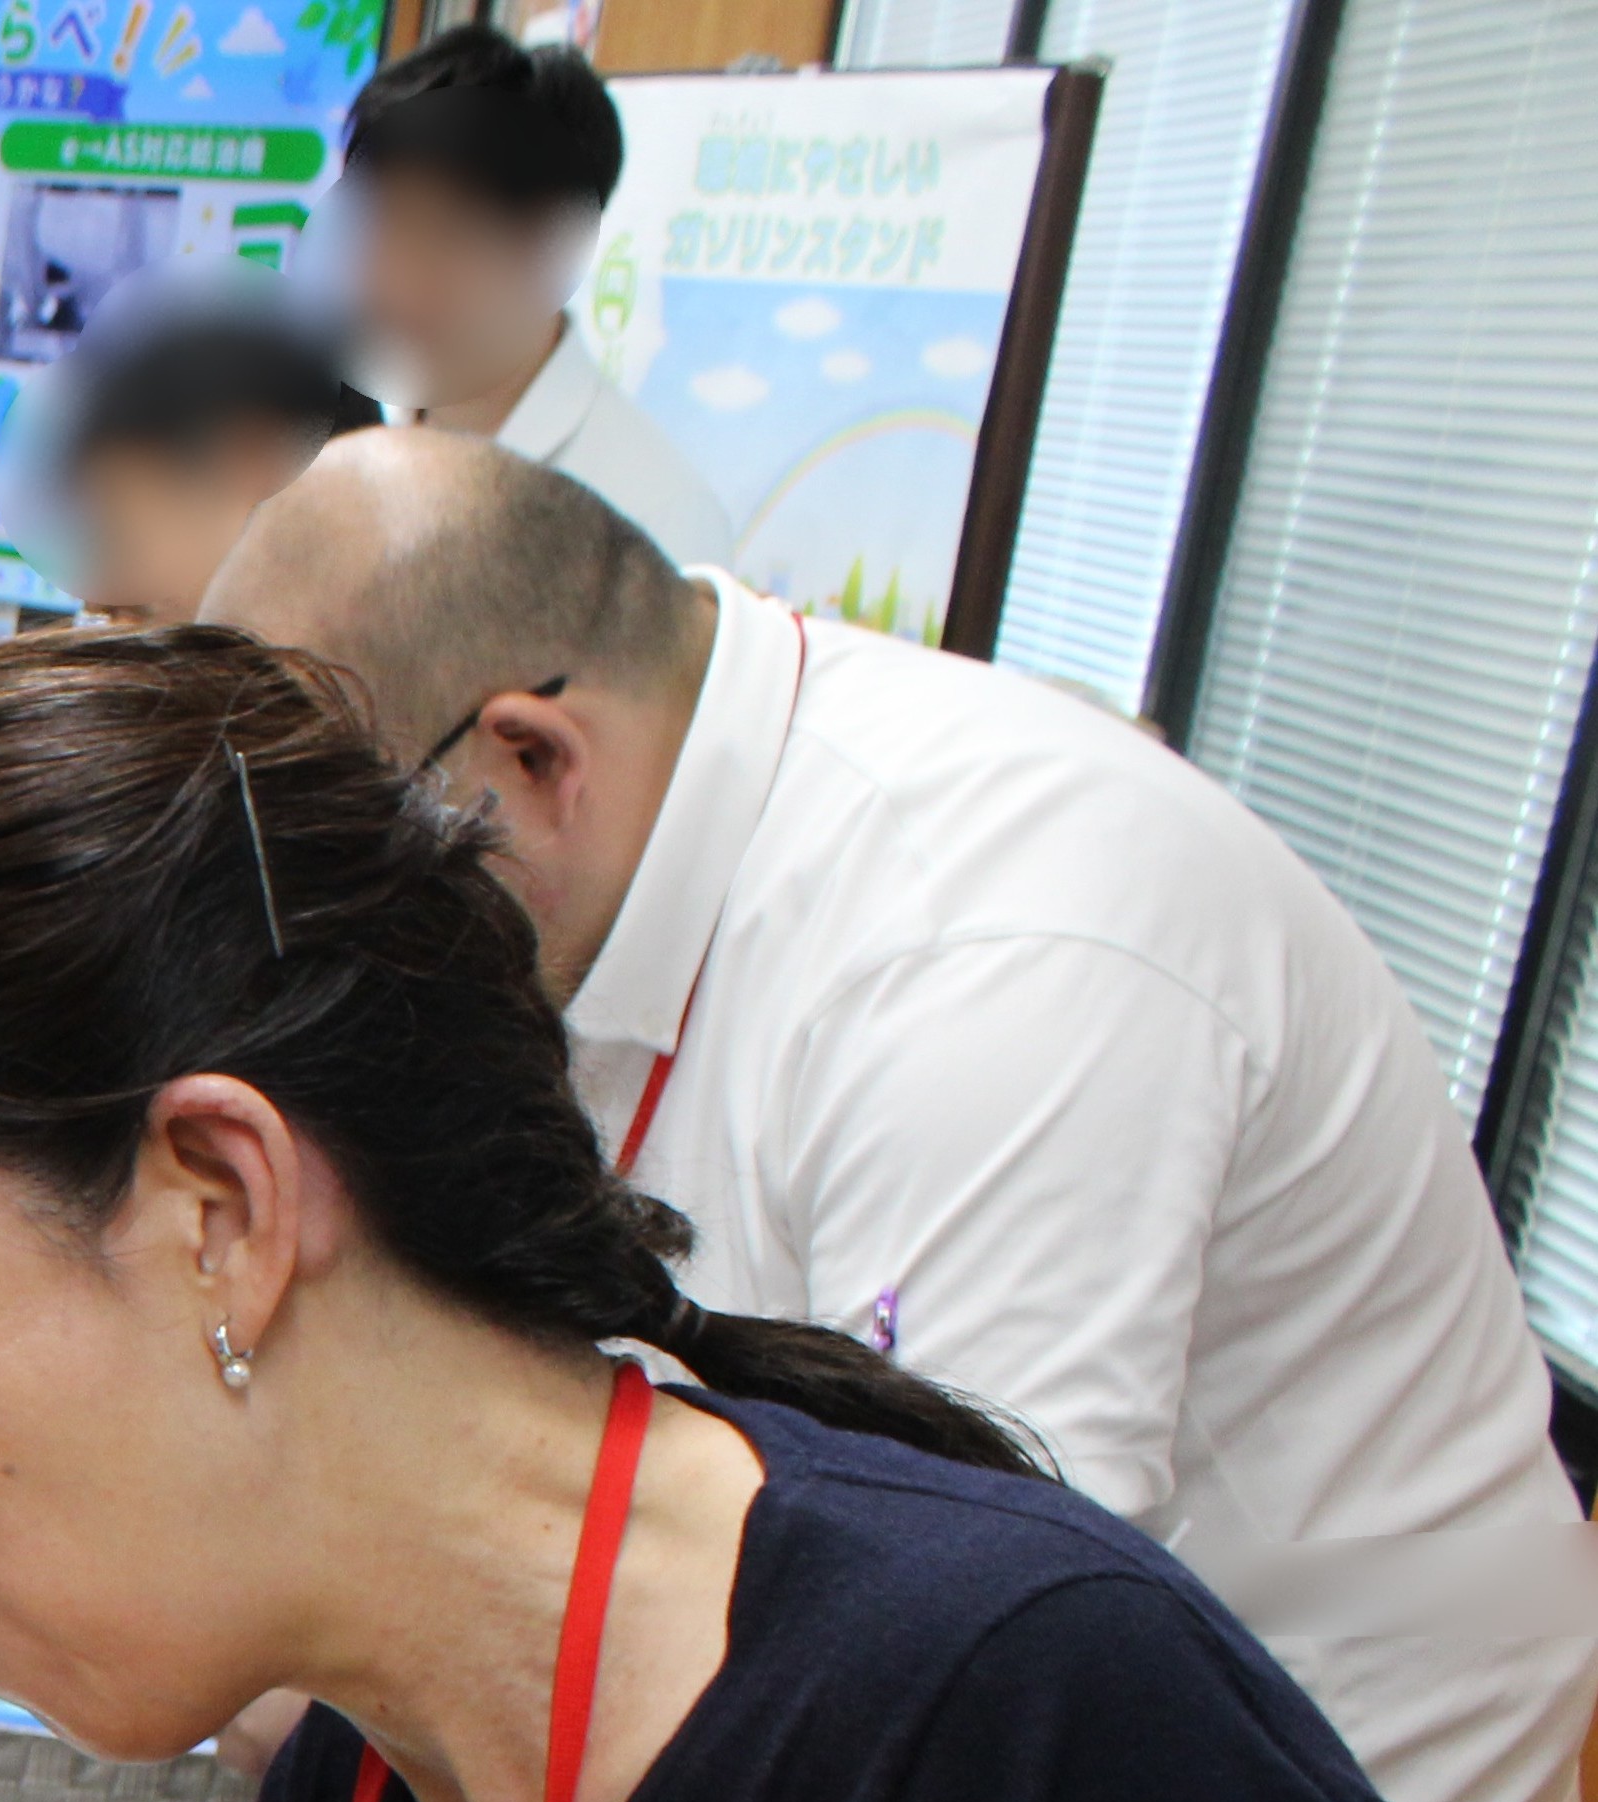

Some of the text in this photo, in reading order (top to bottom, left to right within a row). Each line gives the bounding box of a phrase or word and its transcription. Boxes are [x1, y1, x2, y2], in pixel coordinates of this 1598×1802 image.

[662, 210, 947, 281] ガソリンスタンド
